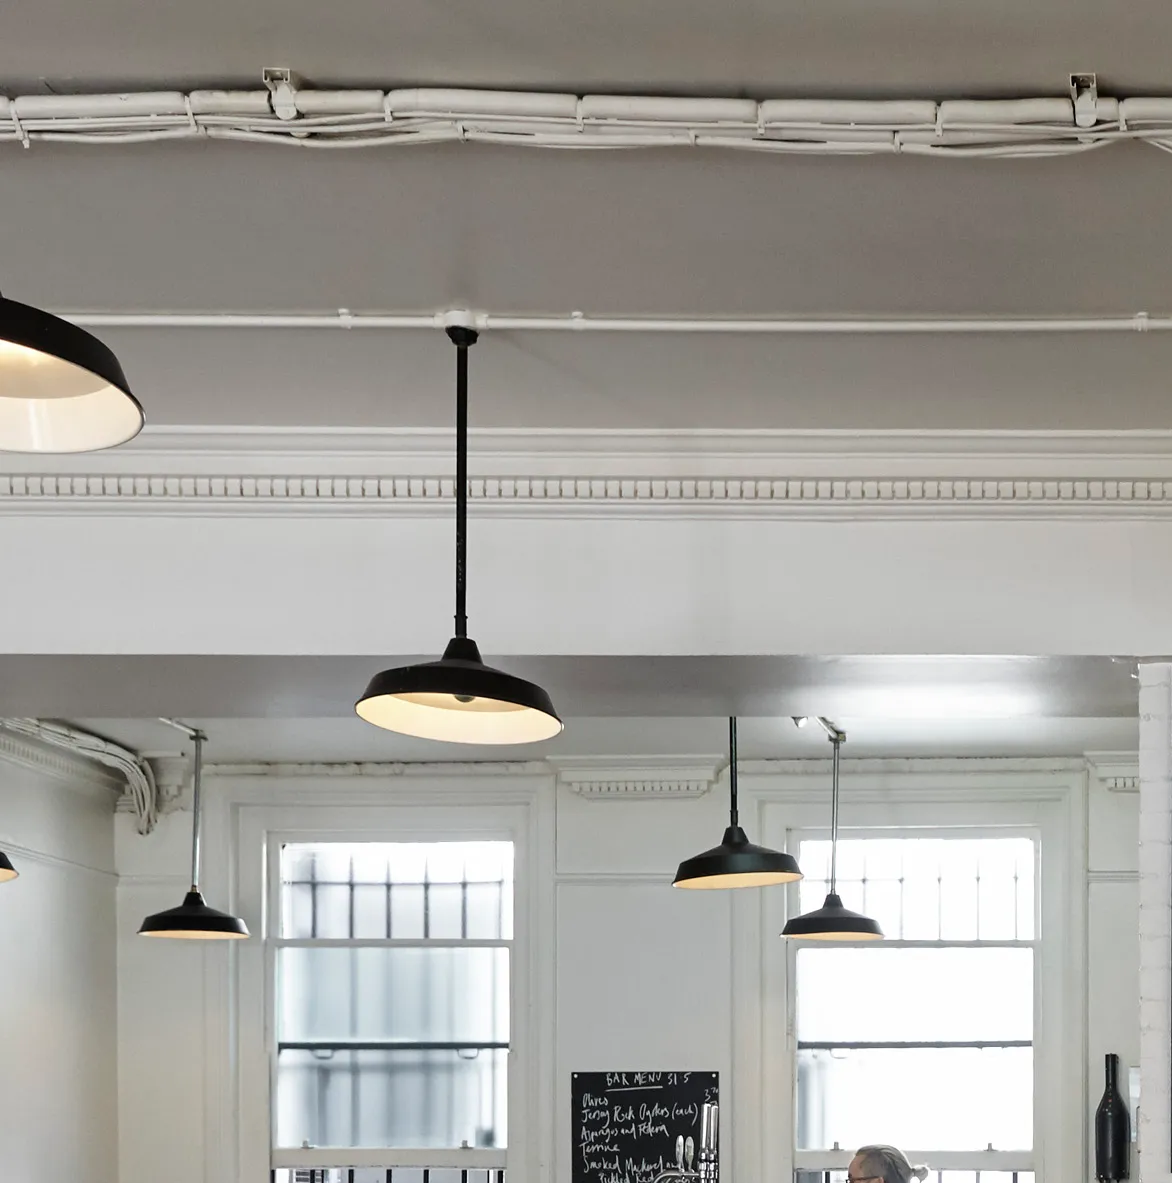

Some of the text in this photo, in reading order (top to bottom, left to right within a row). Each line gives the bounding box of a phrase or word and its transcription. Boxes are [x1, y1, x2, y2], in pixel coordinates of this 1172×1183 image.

[606, 1073, 629, 1087] BAR
[634, 1072, 662, 1085] MENU
[621, 1122, 637, 1139] and
[579, 1141, 620, 1156] Terrine
[583, 1155, 622, 1173] Smoked
